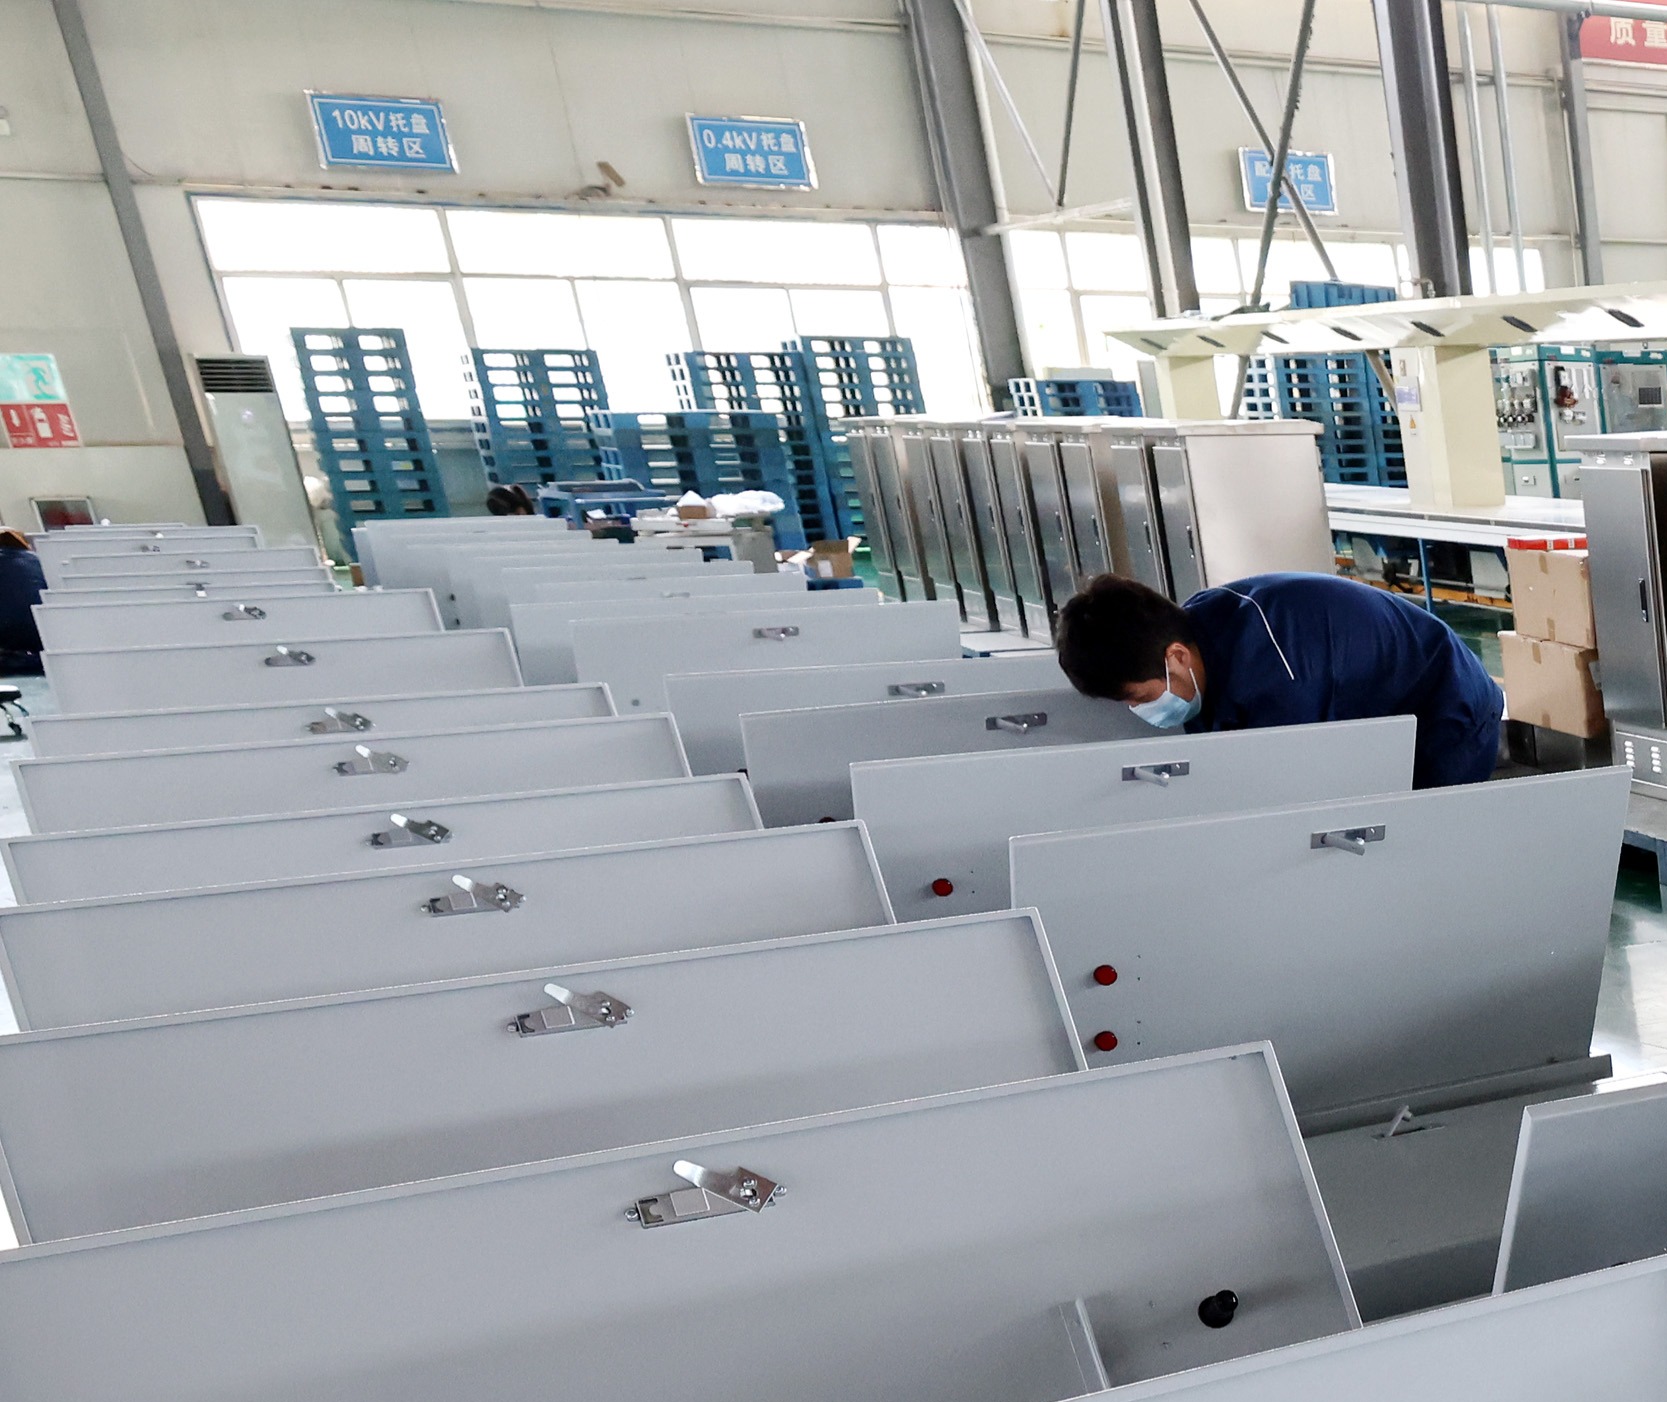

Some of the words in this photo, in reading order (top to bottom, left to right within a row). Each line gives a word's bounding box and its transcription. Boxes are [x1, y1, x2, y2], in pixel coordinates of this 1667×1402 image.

[331, 108, 430, 134] 10kV托盘
[351, 134, 426, 159] 周转区
[702, 128, 797, 153] 0.4kV托盘
[724, 153, 789, 175] 周转区
[1254, 160, 1322, 182] 配托盘
